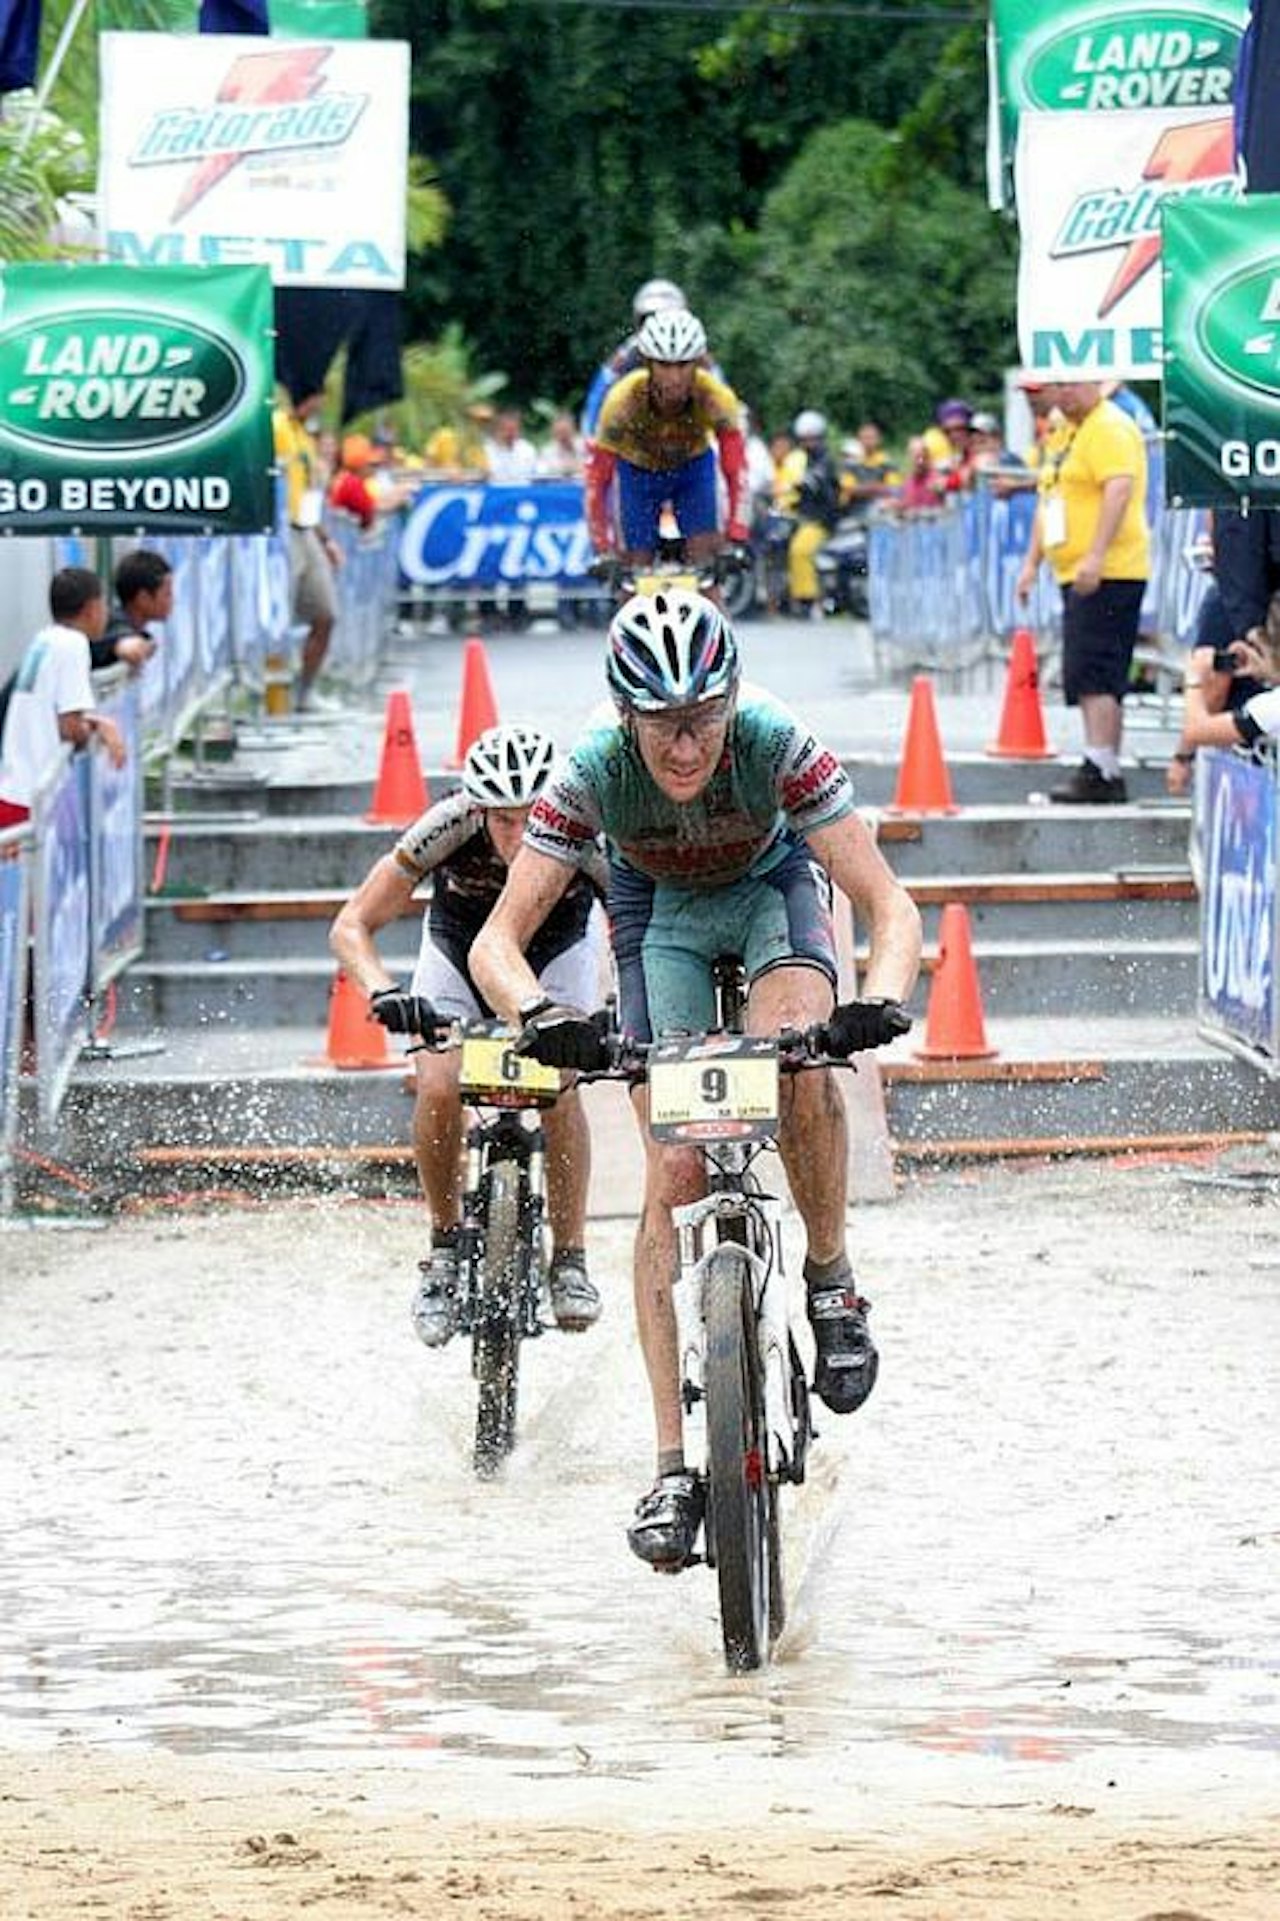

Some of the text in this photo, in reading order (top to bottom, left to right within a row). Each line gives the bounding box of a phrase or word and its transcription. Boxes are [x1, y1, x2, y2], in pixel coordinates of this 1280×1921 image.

[1072, 33, 1196, 74] LAND
[1086, 68, 1232, 109] ROVER
[140, 95, 348, 158] Gatorade
[103, 230, 398, 277] META
[24, 335, 161, 376] LAND
[37, 379, 207, 420] ROVER
[0, 477, 231, 511] GO BEYOND
[502, 1050, 520, 1080] 6
[701, 1067, 727, 1103] 9
